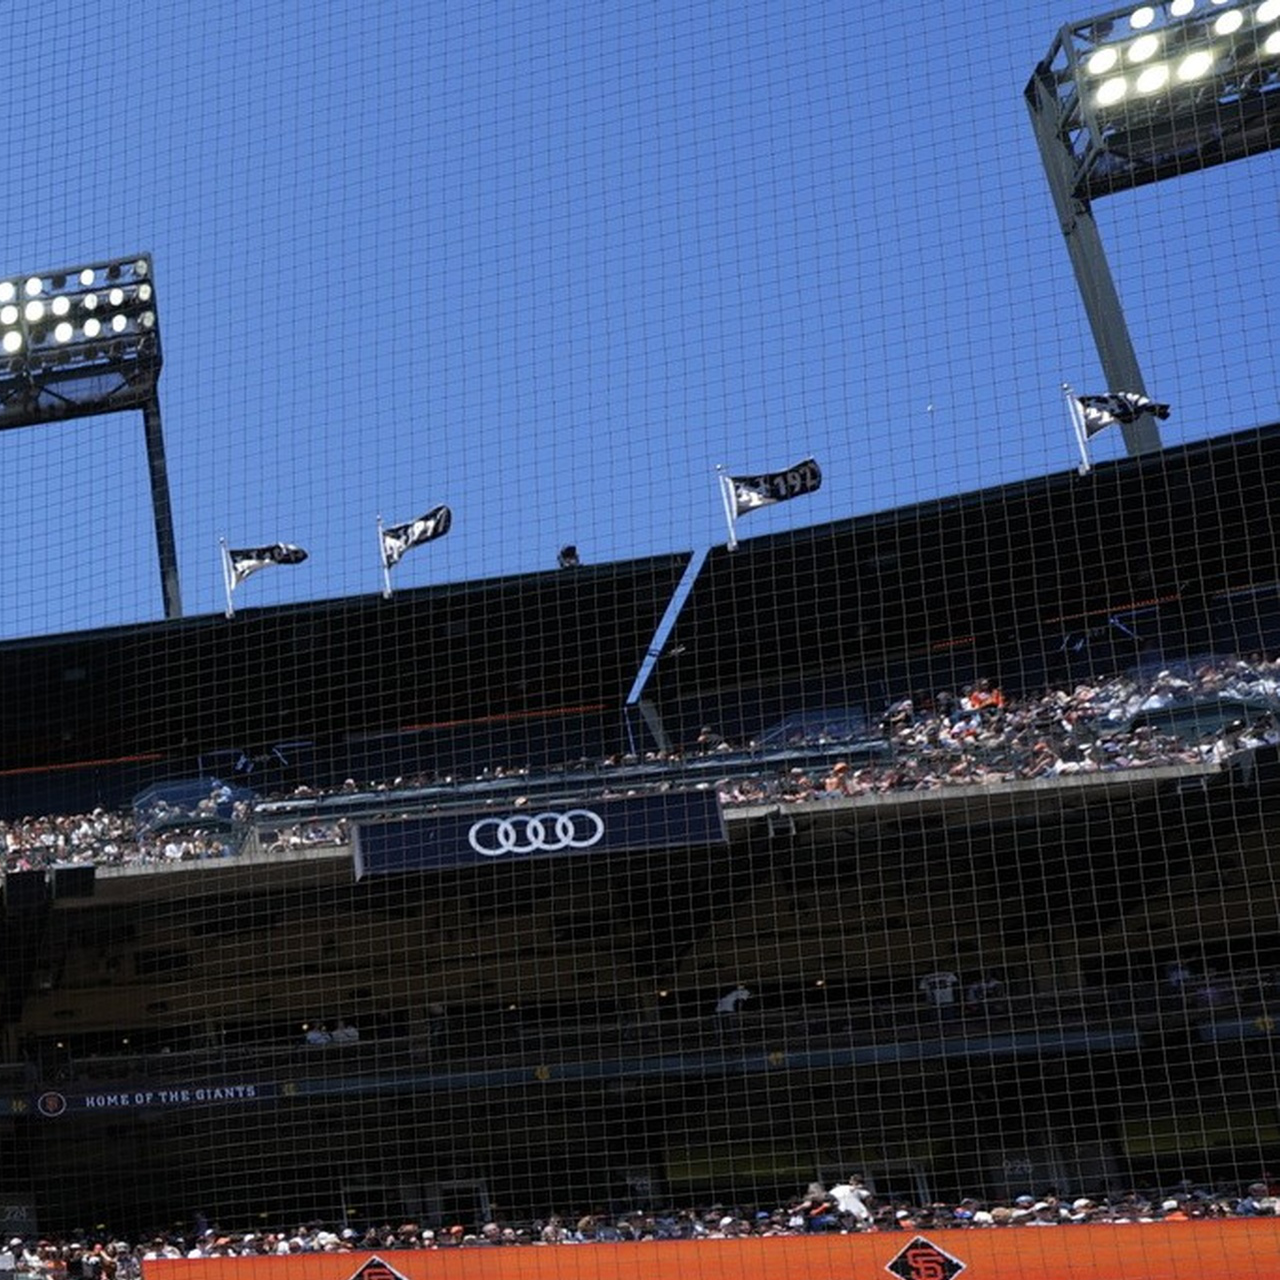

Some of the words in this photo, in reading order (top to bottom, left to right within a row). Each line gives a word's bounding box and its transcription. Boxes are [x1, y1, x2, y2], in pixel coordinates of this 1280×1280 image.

[85, 1093, 130, 1108] HOME
[134, 1092, 154, 1105] OF
[157, 1089, 191, 1103] THE
[195, 1085, 257, 1100] GIANTS
